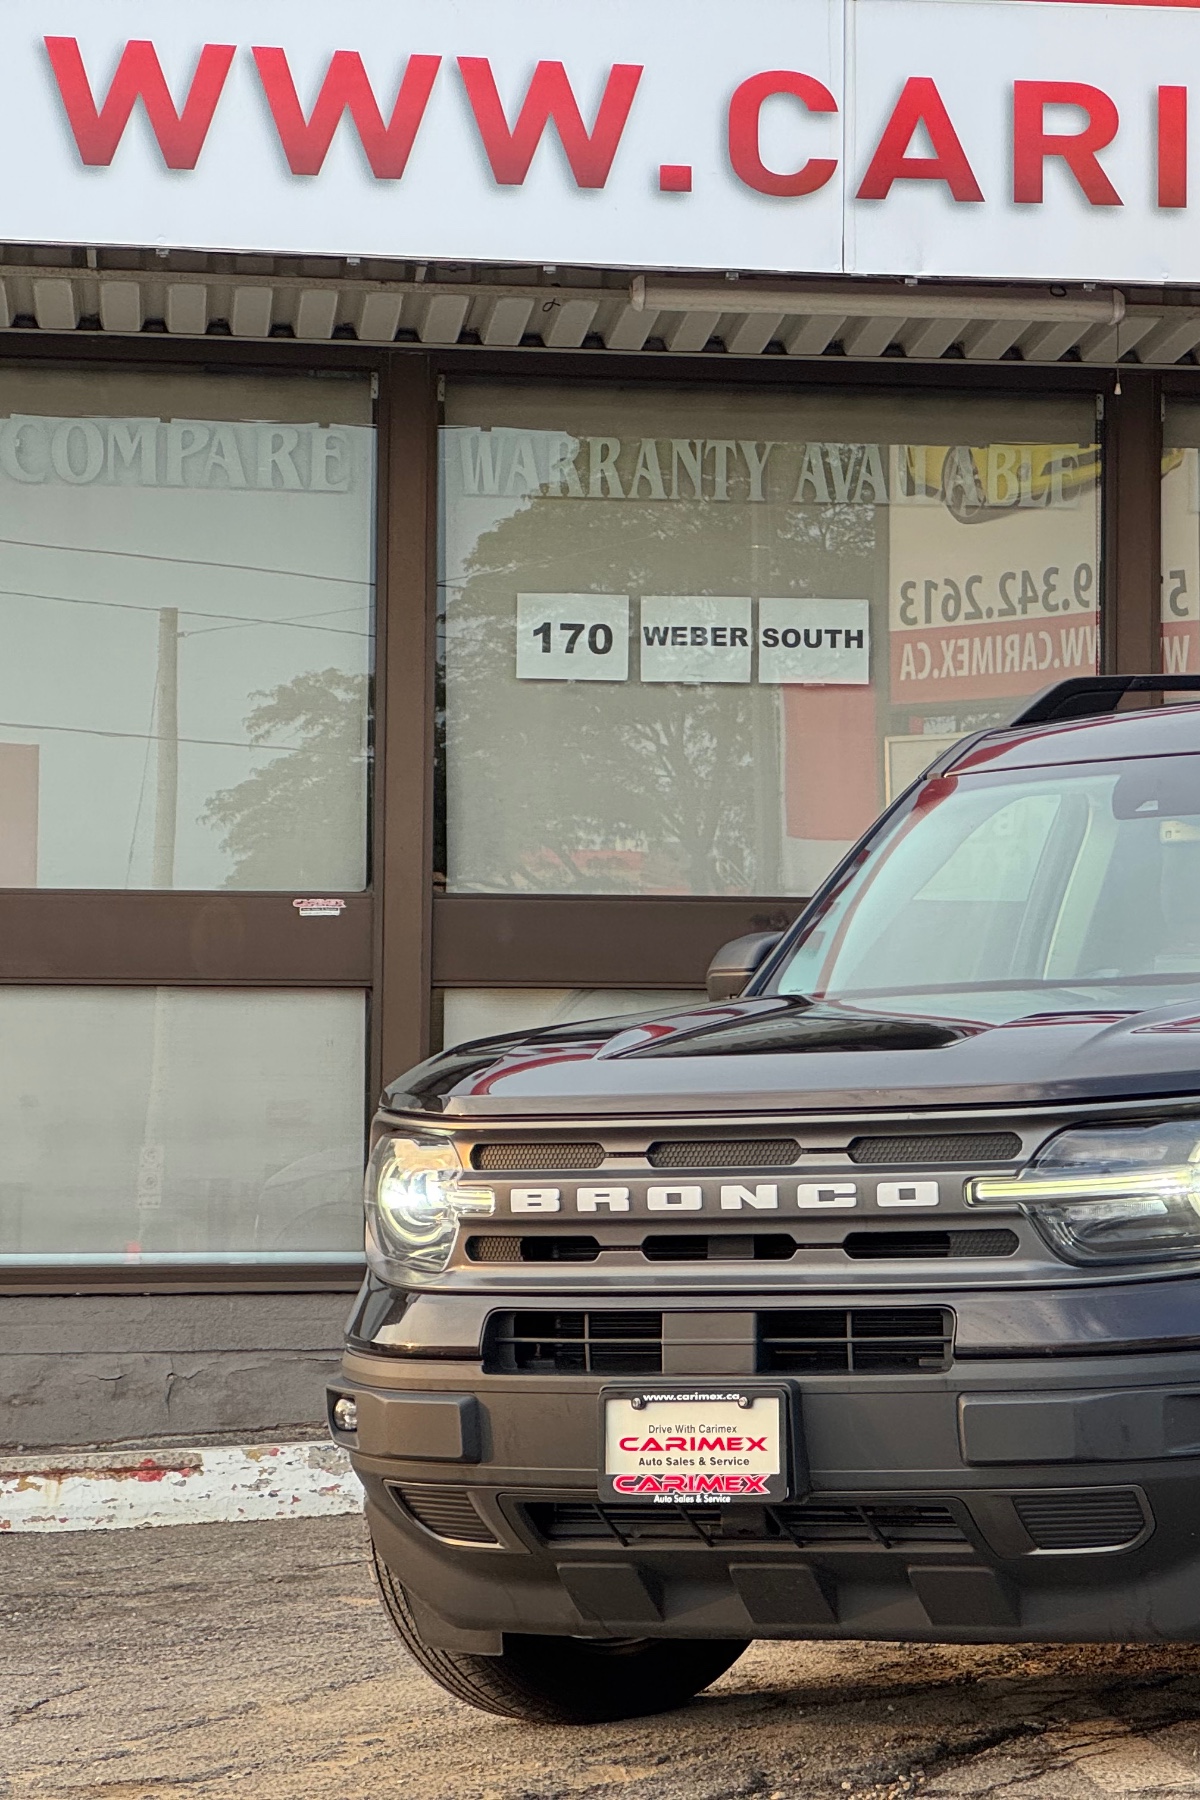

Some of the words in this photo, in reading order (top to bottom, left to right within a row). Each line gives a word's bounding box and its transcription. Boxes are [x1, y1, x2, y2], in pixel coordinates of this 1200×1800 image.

[2, 420, 349, 493] COMPARE
[460, 432, 777, 501] WARRANTY
[794, 442, 1080, 509] AVAILABLE
[532, 621, 613, 655] 170
[643, 626, 749, 647] WEBER
[762, 627, 864, 649] SOUTH
[510, 1181, 939, 1213] BRONCO
[643, 1392, 740, 1401] www.carimex.ca
[648, 1424, 672, 1434] Drive
[675, 1424, 696, 1434] With
[699, 1424, 737, 1434] Carimex
[619, 1436, 768, 1451] CARIMEX
[638, 1457, 662, 1466] Auto
[666, 1457, 695, 1466] Sales
[698, 1457, 706, 1466] &
[709, 1457, 750, 1466] Service
[613, 1474, 770, 1494] CARIMEX
[653, 1494, 672, 1504] Auto
[674, 1494, 696, 1504] Sales
[697, 1494, 703, 1504] &
[703, 1494, 731, 1504] Service
